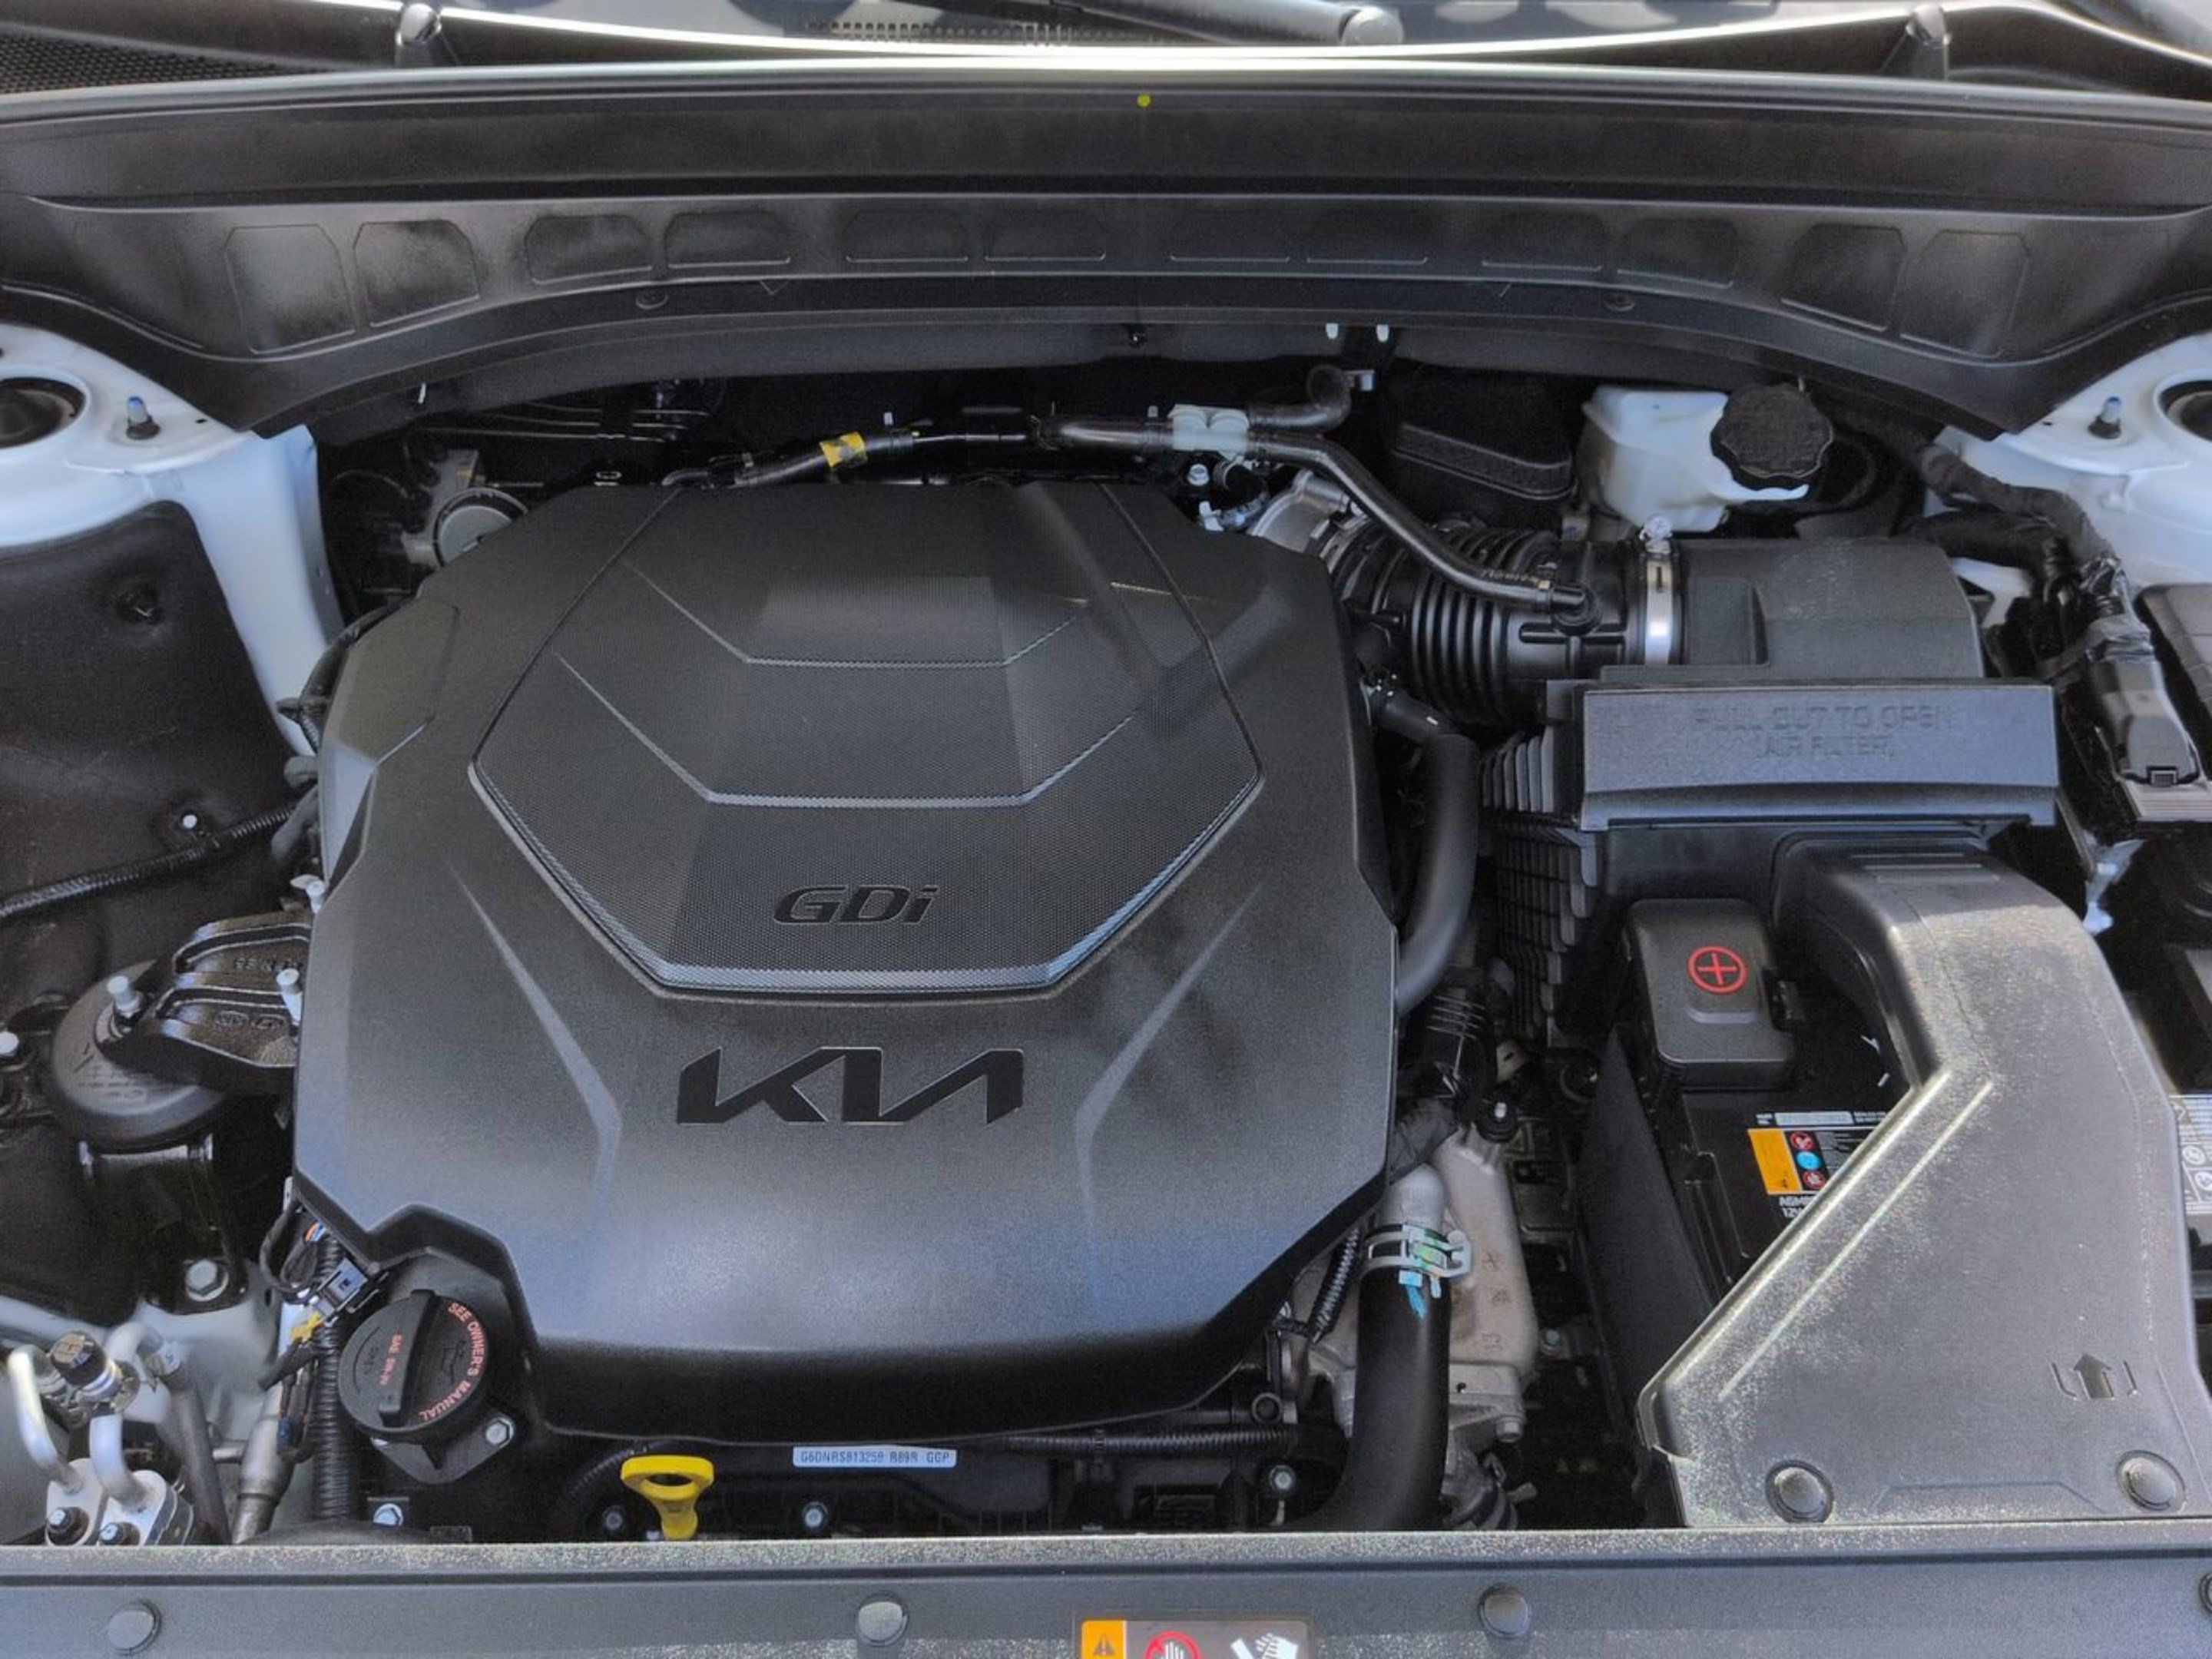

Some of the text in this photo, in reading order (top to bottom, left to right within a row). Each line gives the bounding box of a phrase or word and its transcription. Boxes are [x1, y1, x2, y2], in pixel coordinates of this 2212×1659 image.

[1834, 705, 1871, 729] TO
[773, 884, 939, 924] GDi
[448, 1302, 472, 1323] SEE
[419, 1380, 471, 1421] MANUAL
